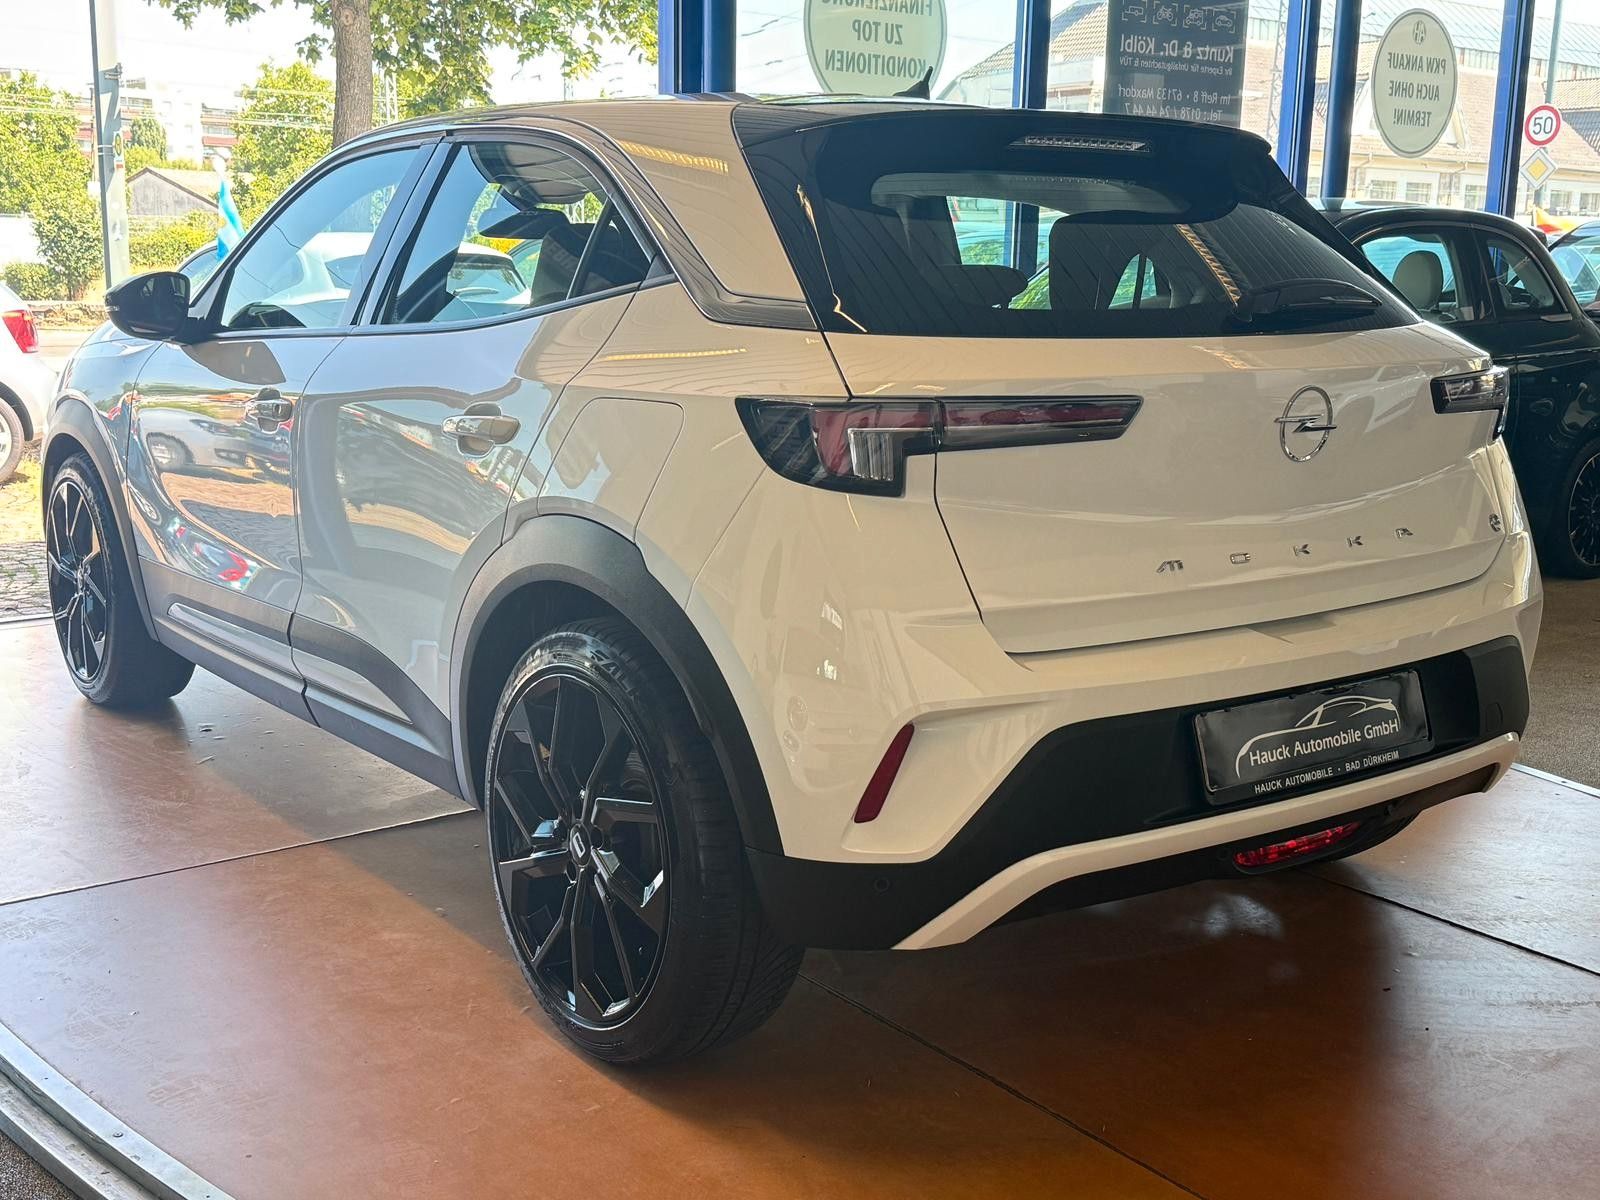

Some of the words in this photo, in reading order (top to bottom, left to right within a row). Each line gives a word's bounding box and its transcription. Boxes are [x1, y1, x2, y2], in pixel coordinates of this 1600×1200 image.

[1532, 116, 1554, 135] 50
[1249, 744, 1291, 767] Hauck
[1293, 727, 1362, 757] Automobile
[1364, 718, 1399, 741] GmbH
[1254, 778, 1282, 794] HAUCK
[1285, 767, 1333, 786] AUTOMOBILE
[1345, 760, 1360, 772] BAD
[1363, 750, 1400, 767] DÜRKHEIM
